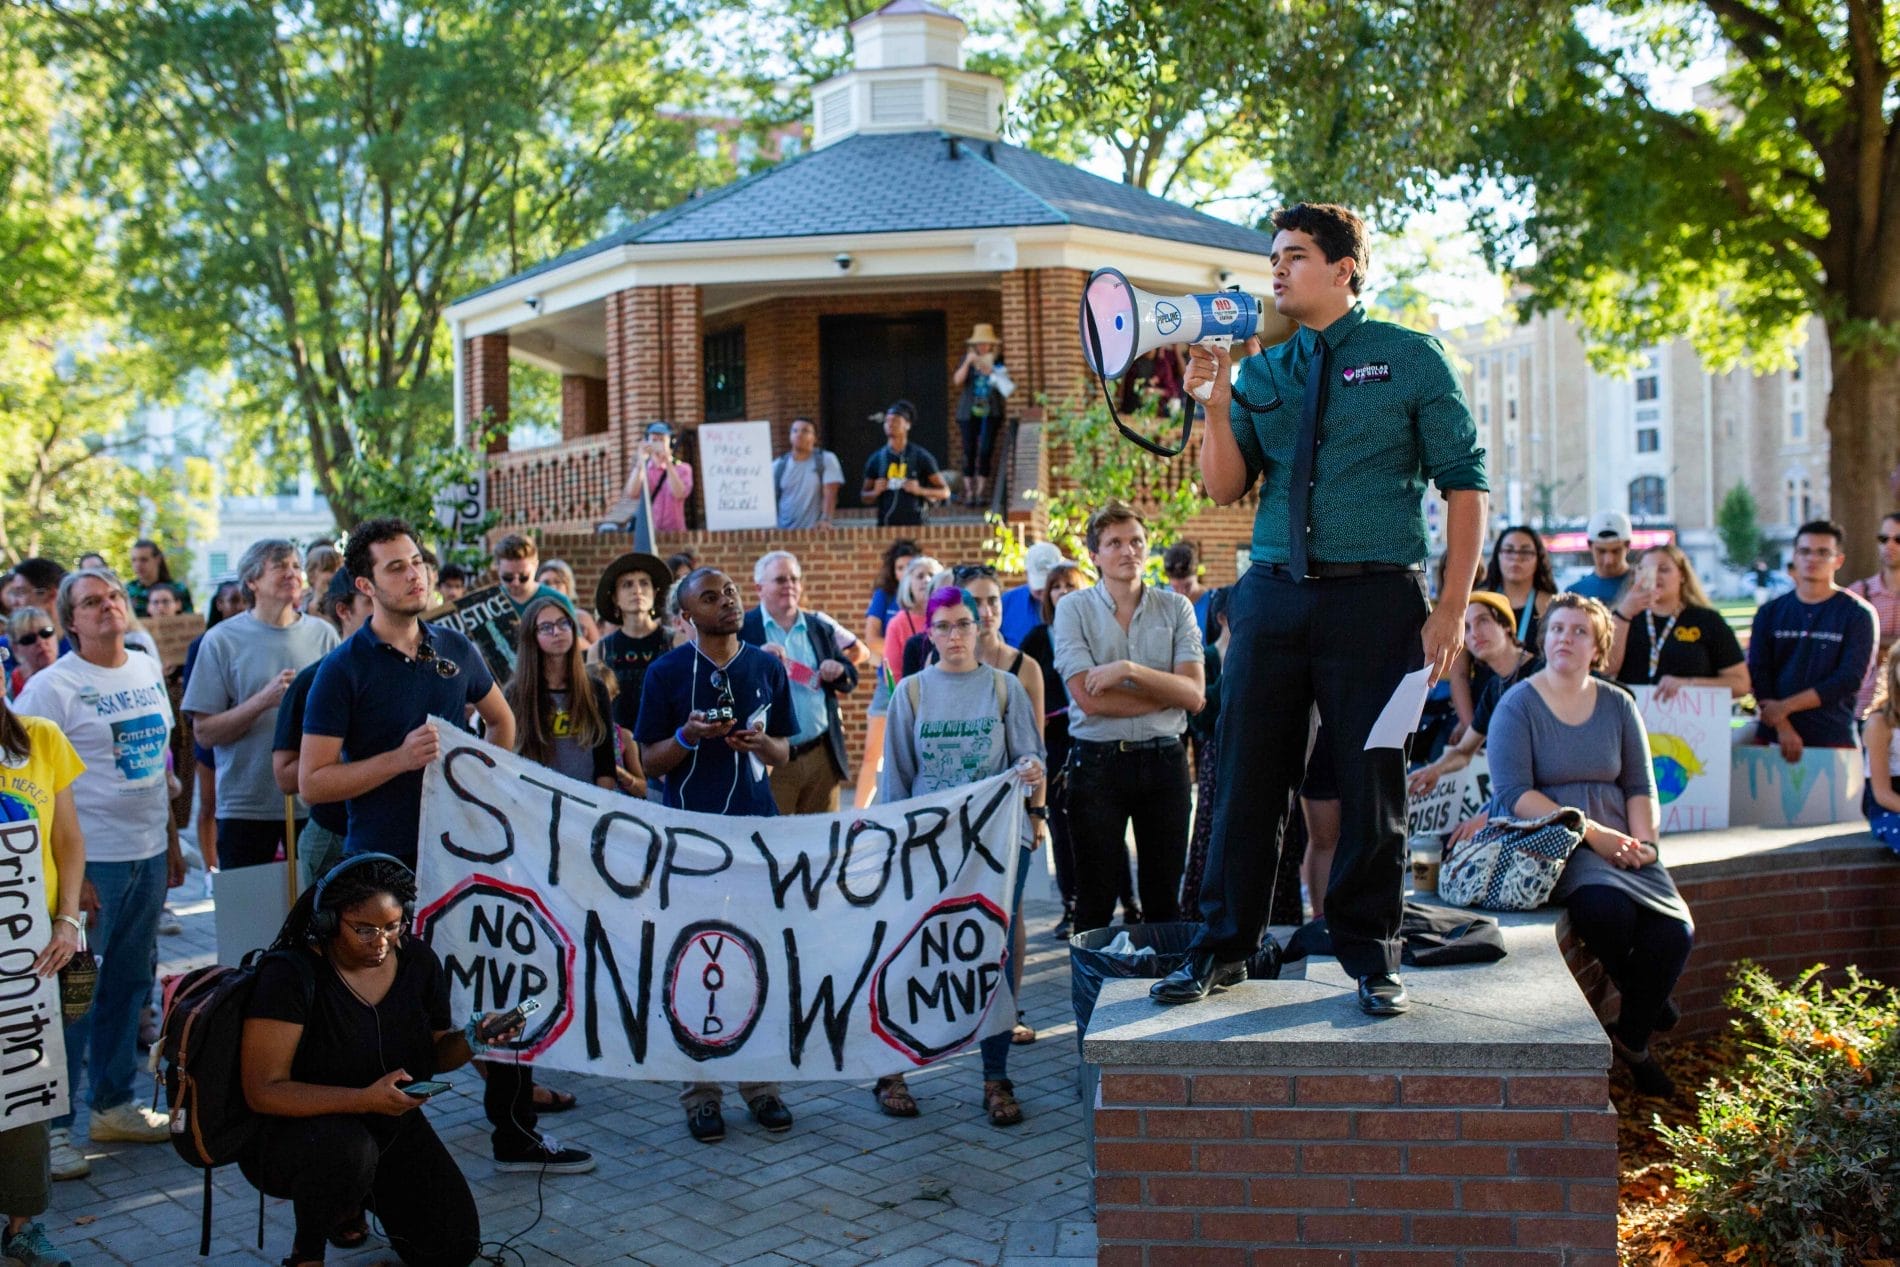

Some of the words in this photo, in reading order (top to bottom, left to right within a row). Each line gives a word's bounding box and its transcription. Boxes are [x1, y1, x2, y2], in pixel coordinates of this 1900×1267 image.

[1215, 299, 1231, 311] NO
[96, 694, 120, 716] ASK
[115, 690, 134, 710] ME
[118, 725, 166, 743] CITIZENS
[440, 746, 733, 910] STOP
[750, 781, 1011, 911] WORK
[1408, 801, 1451, 837] RISIS
[469, 904, 537, 955] NO
[920, 918, 985, 968] NO
[443, 953, 548, 1013] MVP
[584, 909, 887, 1072] NOW
[700, 936, 725, 1035] VOID
[907, 962, 1001, 1025] MVP
